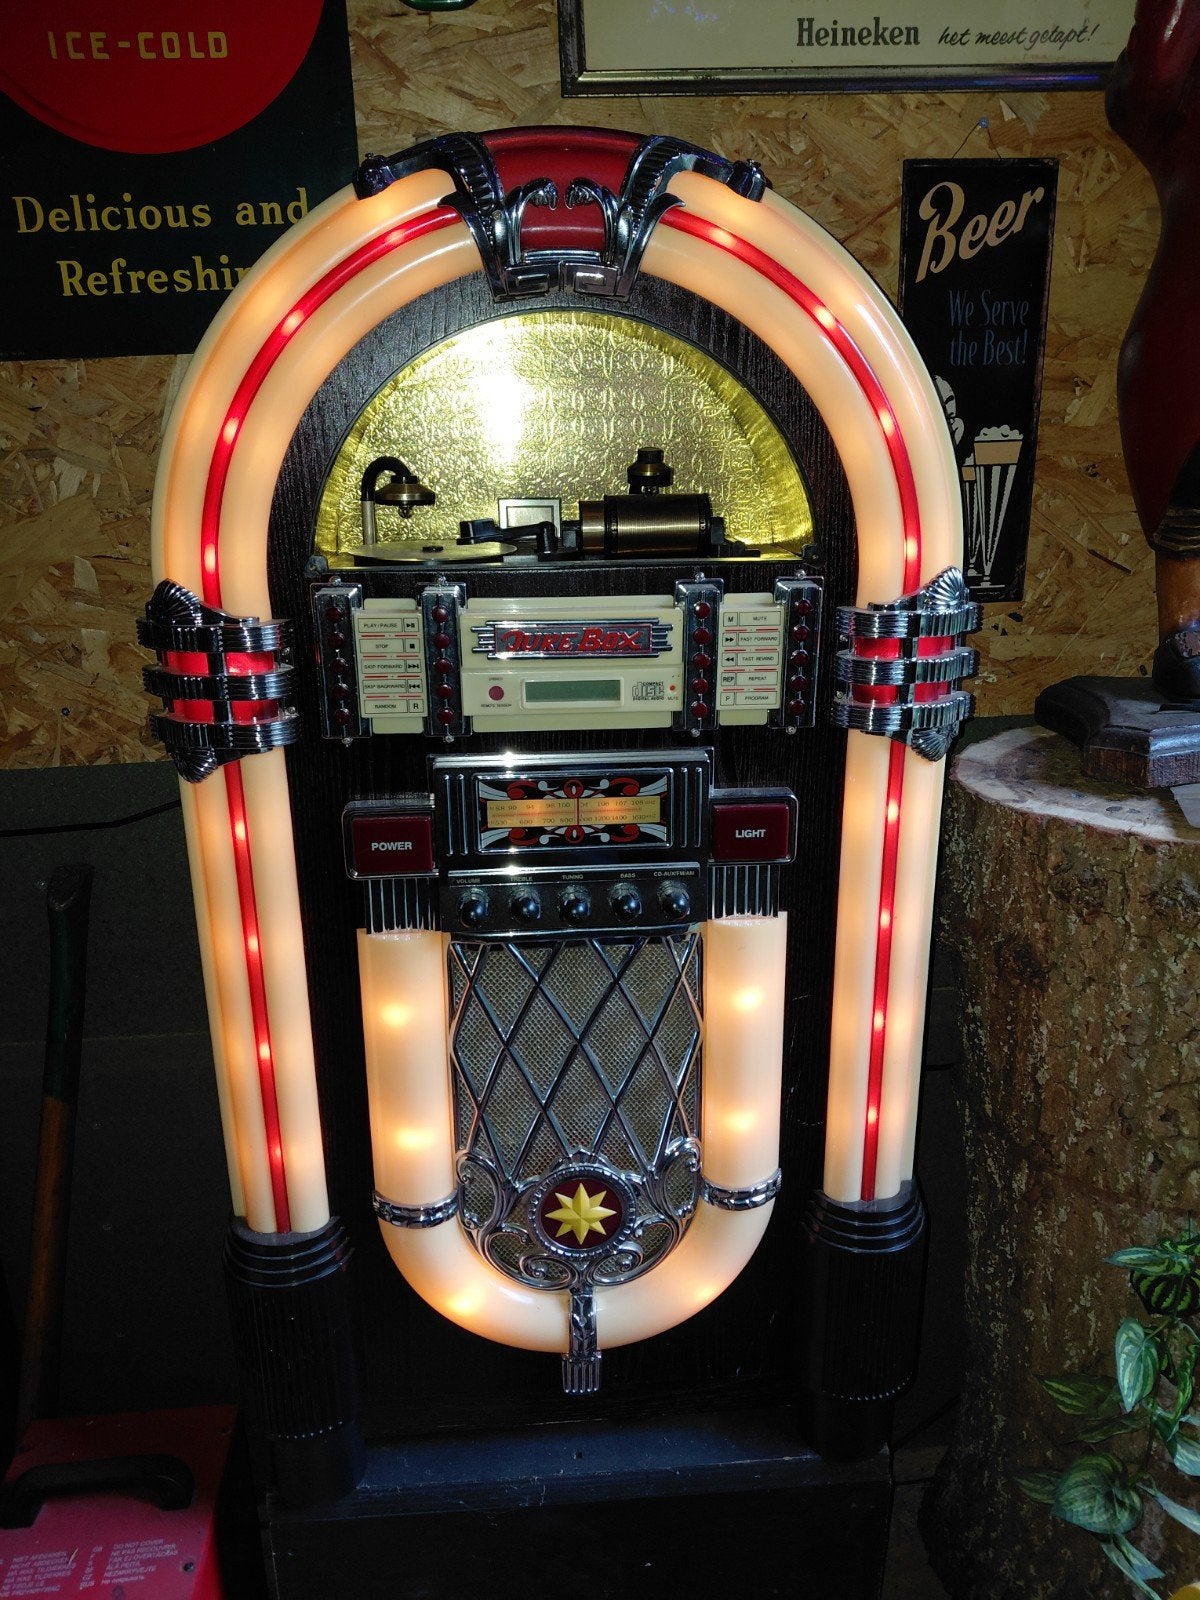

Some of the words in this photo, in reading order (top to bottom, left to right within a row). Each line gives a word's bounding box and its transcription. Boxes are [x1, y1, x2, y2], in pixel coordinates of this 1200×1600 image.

[48, 31, 228, 60] ICE-COLD
[796, 16, 920, 47] Heineken
[938, 26, 969, 46] het
[974, 28, 1028, 46] meest
[1028, 24, 1100, 50] getapt!
[12, 192, 212, 233] Delicious
[236, 187, 308, 225] and
[916, 182, 1044, 283] Beer
[56, 254, 252, 297] Refreshi
[950, 290, 974, 326] We
[981, 290, 1029, 326] Serve
[950, 329, 978, 366] the
[983, 328, 1028, 366] Best!
[371, 842, 412, 851] POWER
[735, 829, 766, 838] LIGHT
